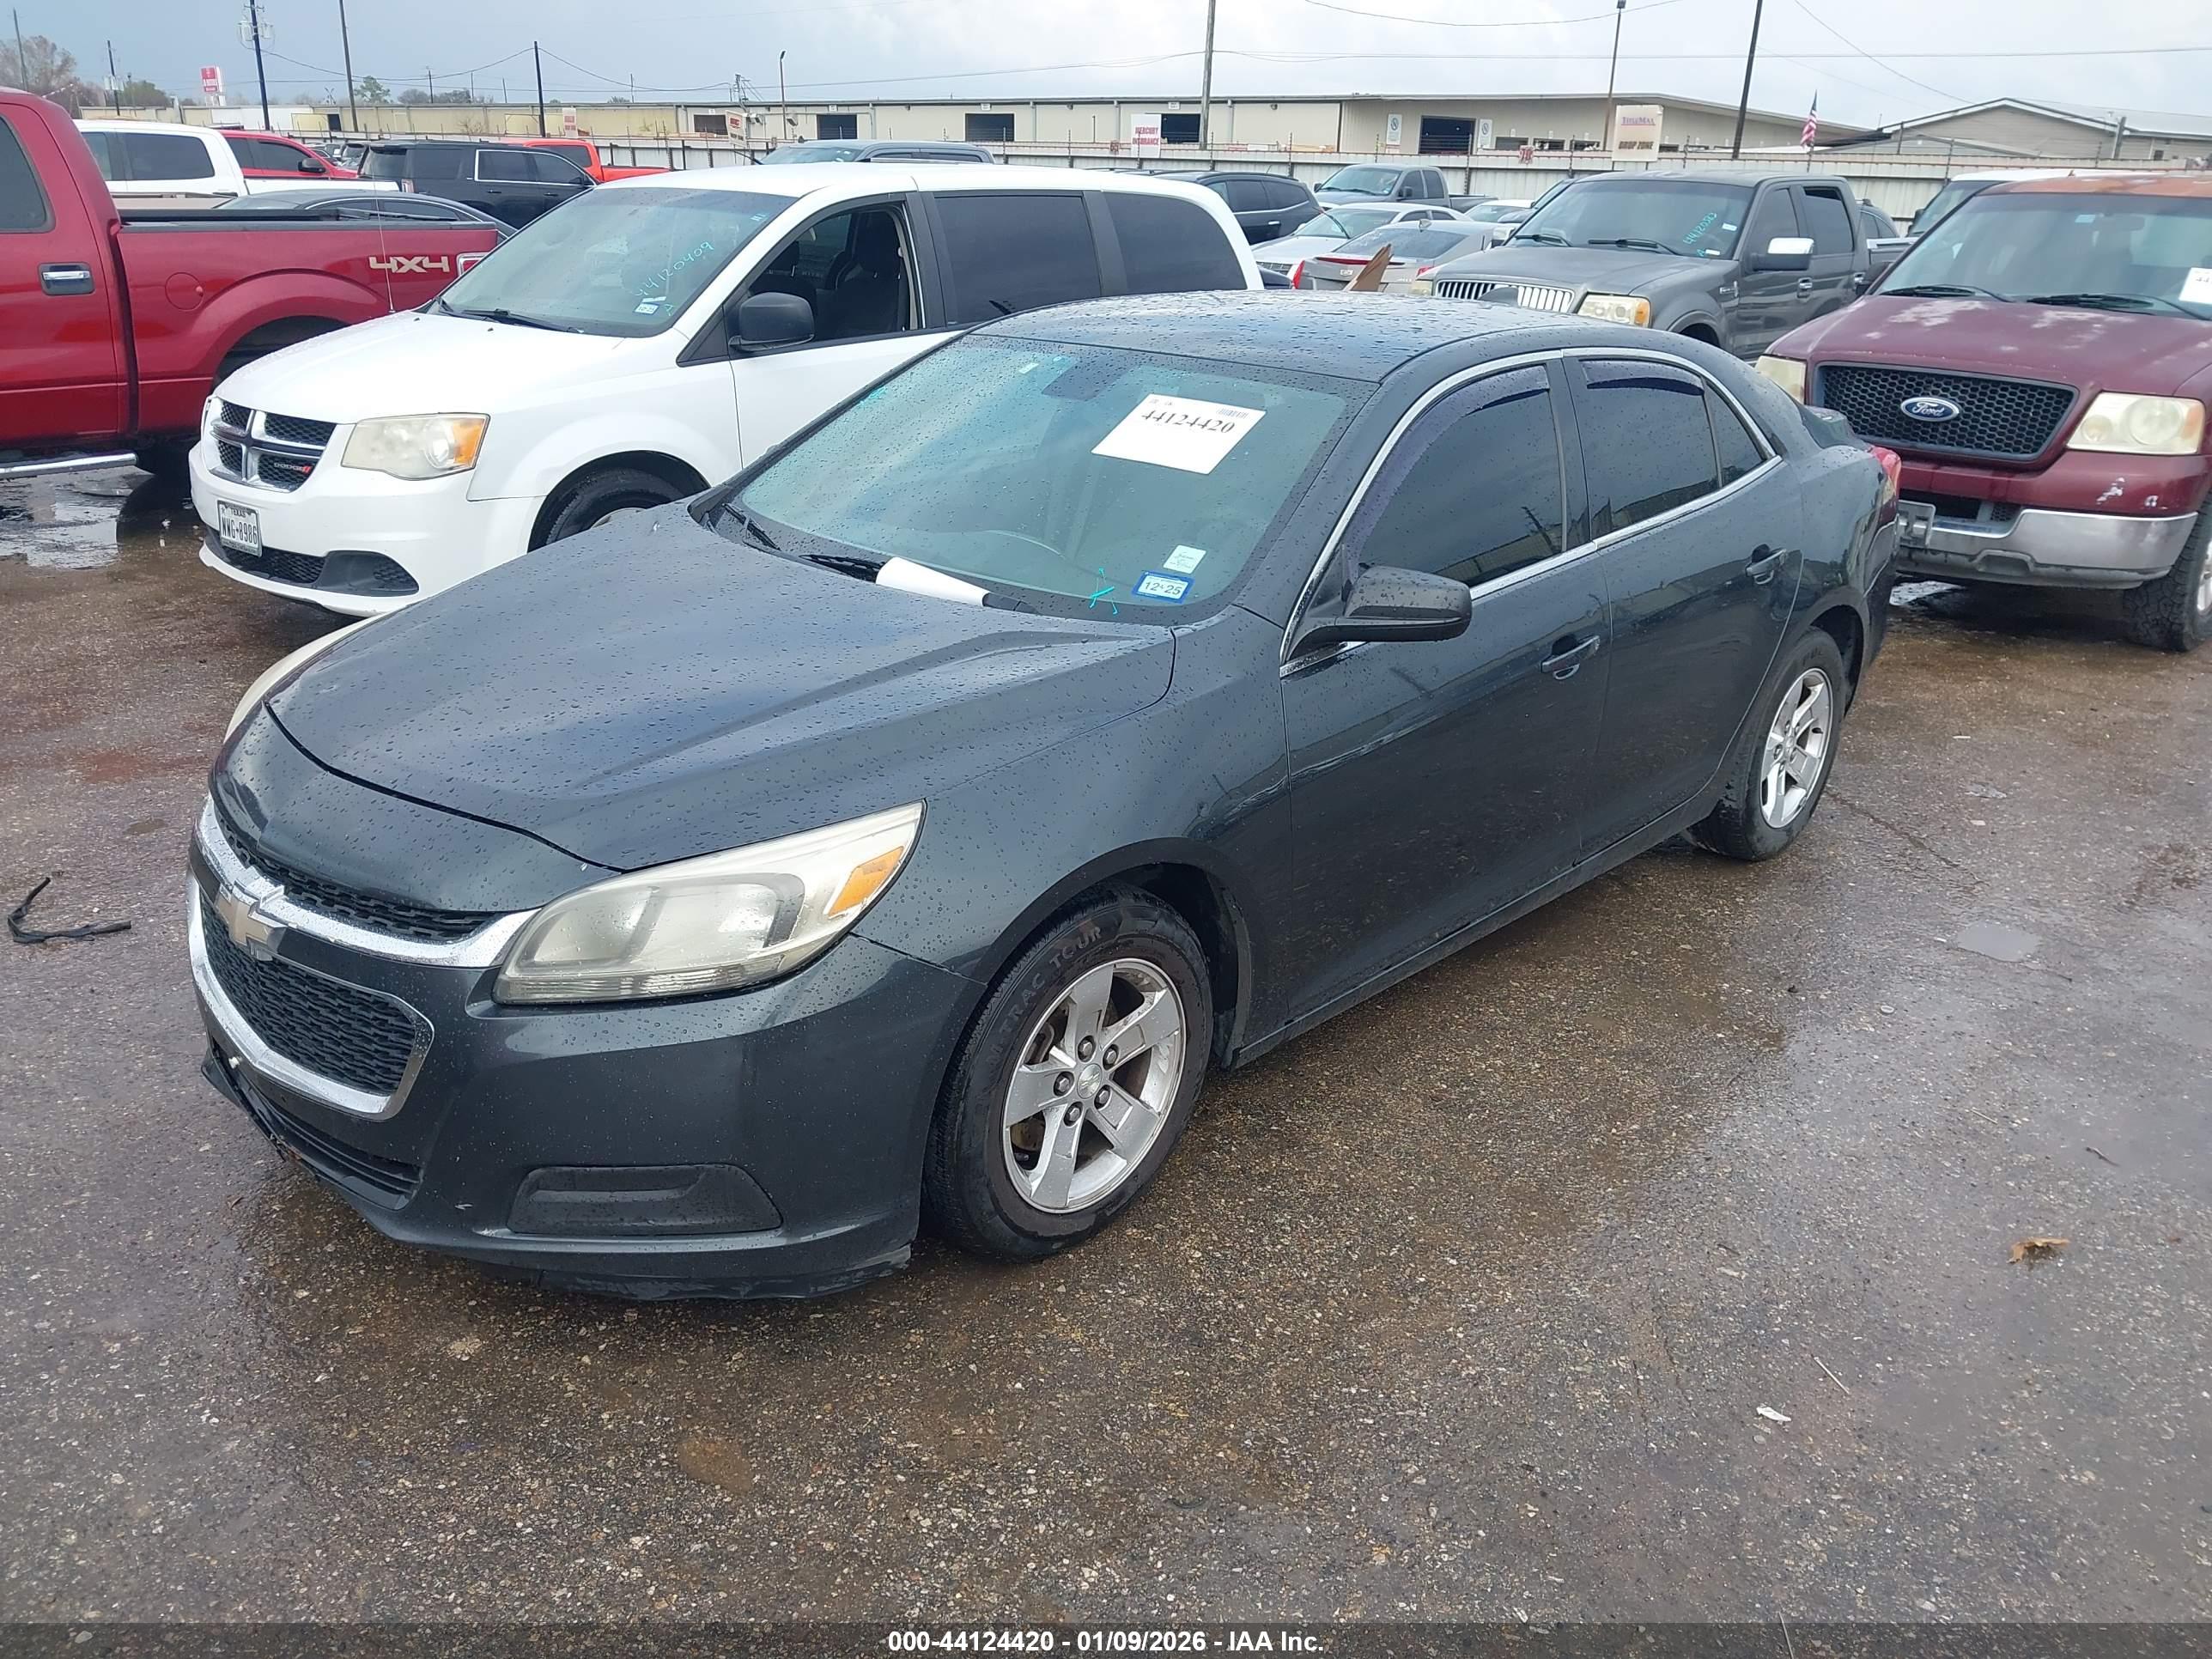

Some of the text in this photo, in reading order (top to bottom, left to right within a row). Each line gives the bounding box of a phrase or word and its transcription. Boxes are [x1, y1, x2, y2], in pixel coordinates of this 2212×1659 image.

[1911, 402, 1945, 416] Ford
[1141, 410, 1235, 434] 44124420
[273, 462, 304, 472] DODGE
[229, 507, 246, 518] TEXAS
[1049, 926, 1102, 969] TOUR
